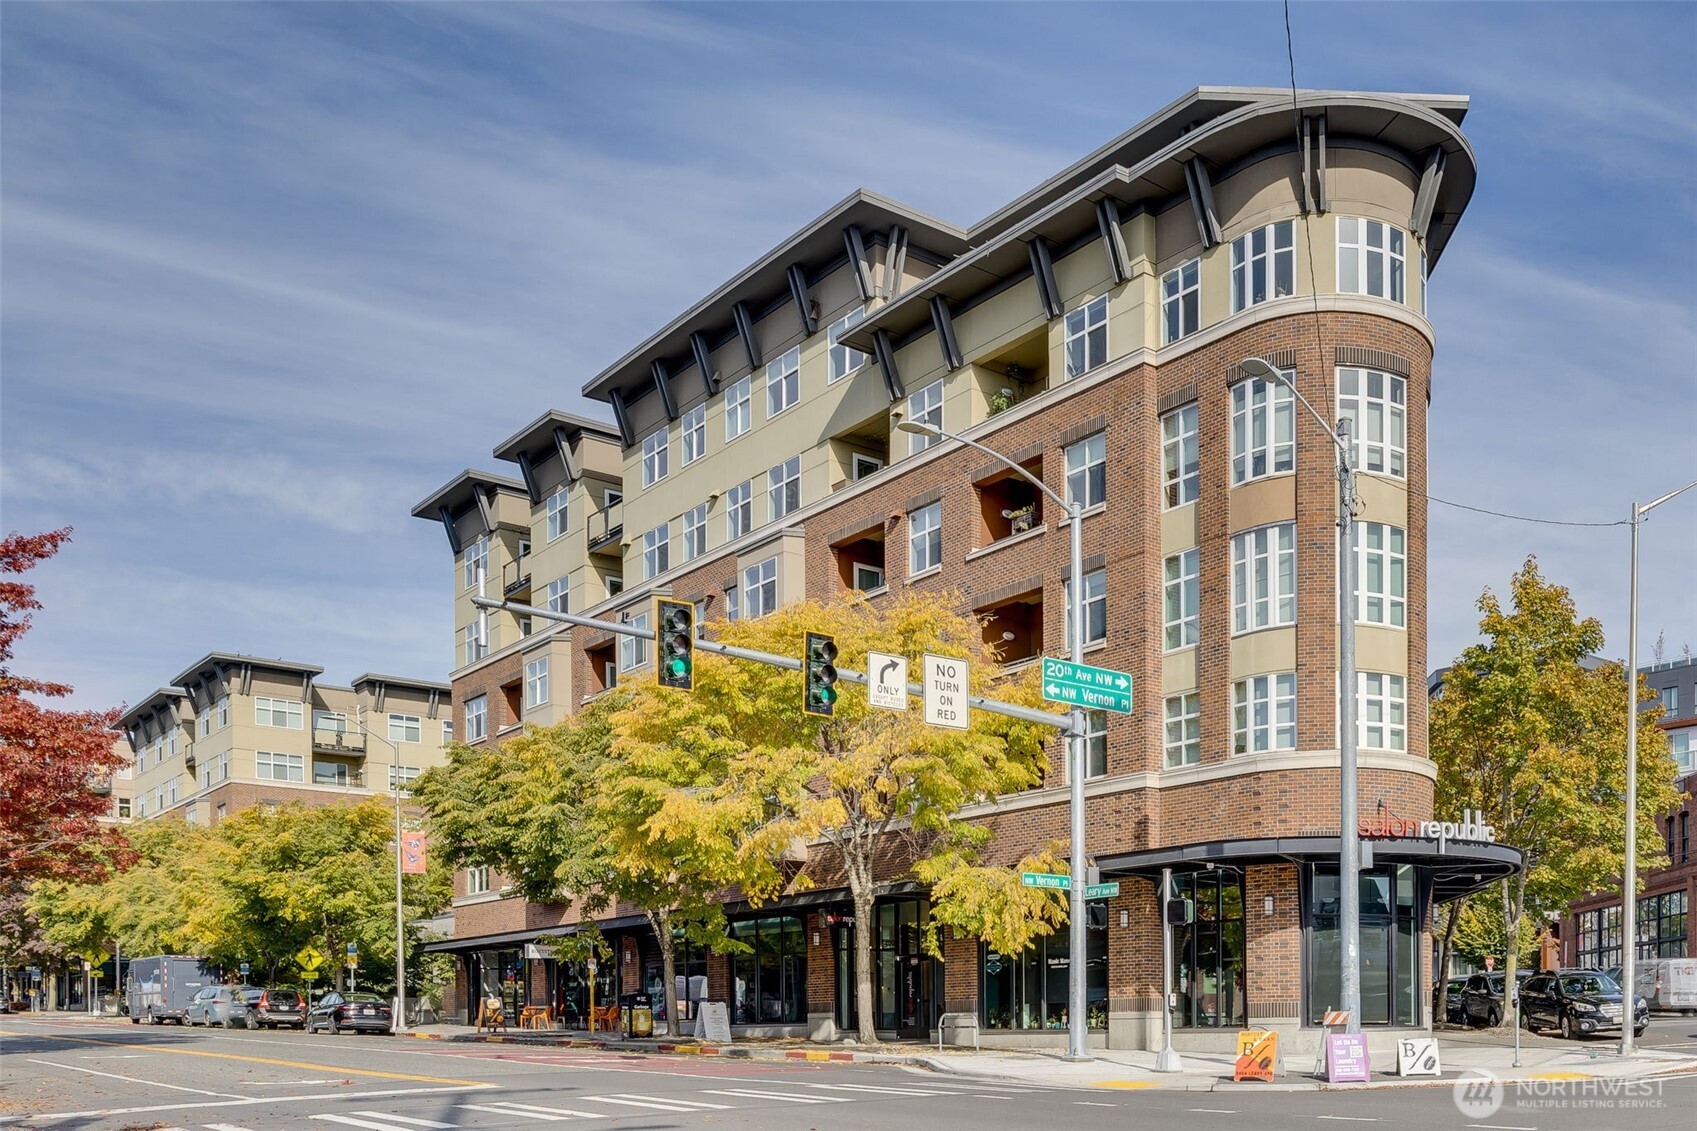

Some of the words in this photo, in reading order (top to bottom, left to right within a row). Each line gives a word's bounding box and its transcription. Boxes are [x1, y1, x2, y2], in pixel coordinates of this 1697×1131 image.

[936, 664, 956, 678] NO
[1047, 662, 1072, 677] 20th
[1075, 669, 1091, 682] Ave
[1095, 673, 1112, 686] NW
[877, 684, 899, 696] ONLY
[934, 680, 959, 693] TURN
[940, 695, 953, 706] ON
[1062, 687, 1077, 699] NW
[1082, 688, 1115, 707] Vernon
[1121, 699, 1129, 709] Pl
[937, 709, 956, 721] RED
[1035, 875, 1060, 887] Vernon
[1085, 886, 1102, 897] Leary
